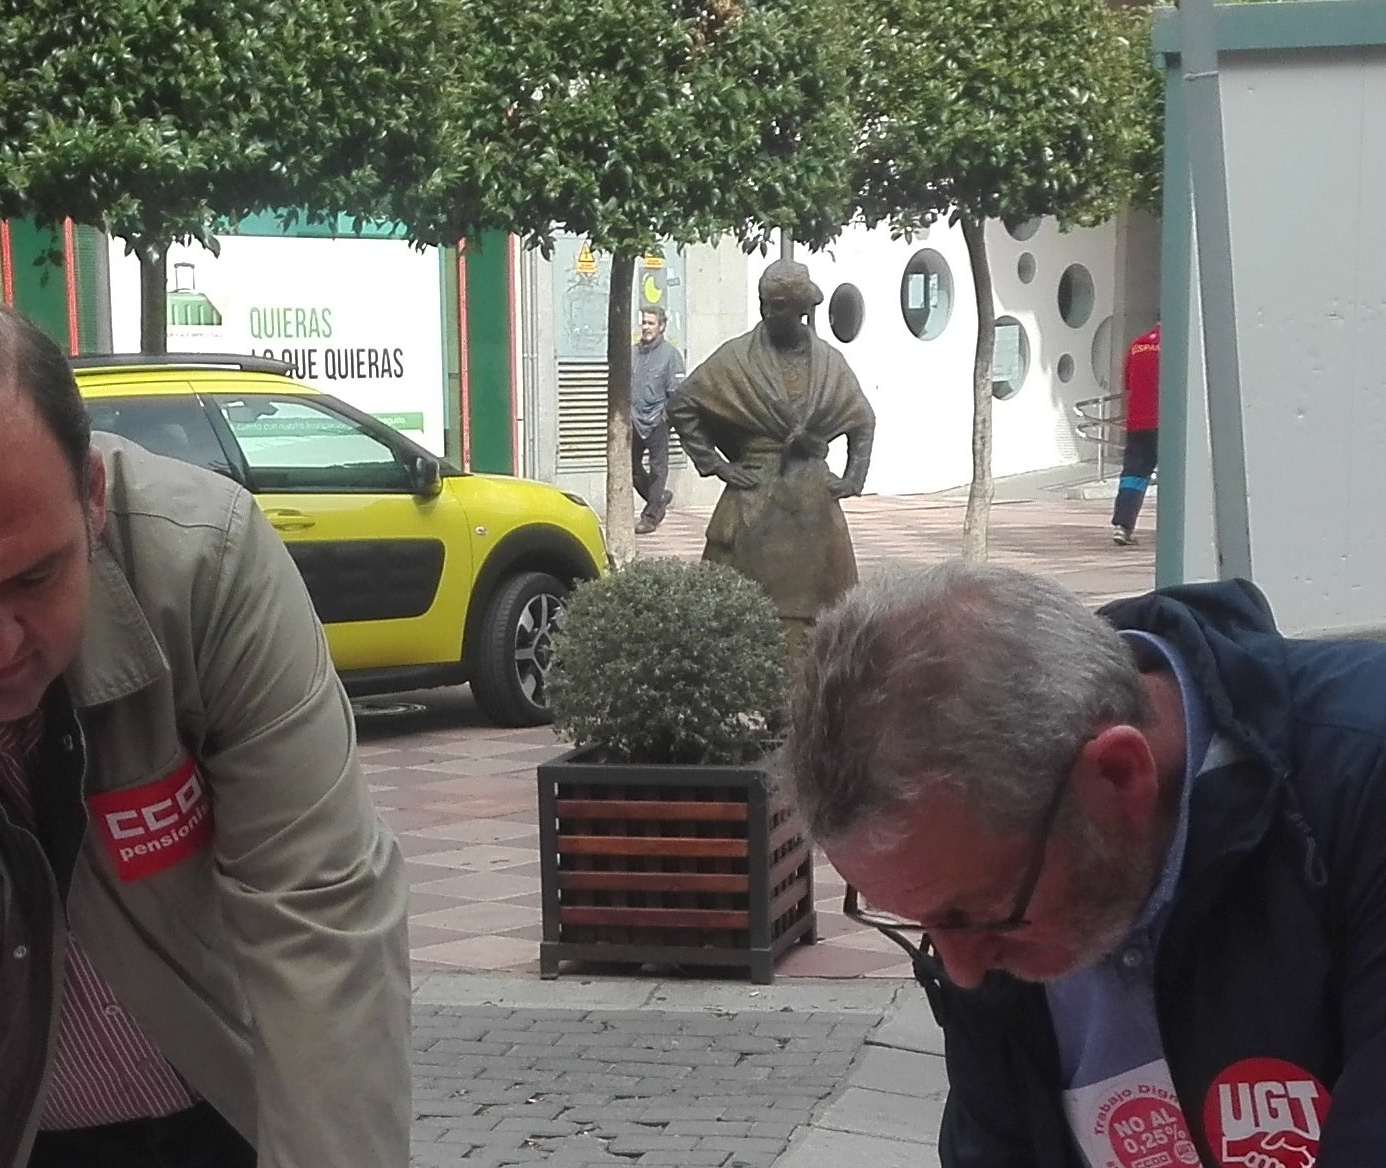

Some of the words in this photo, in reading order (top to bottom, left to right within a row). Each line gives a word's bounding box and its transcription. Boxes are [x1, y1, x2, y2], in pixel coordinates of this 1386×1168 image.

[250, 307, 332, 339] QUIERAS
[325, 348, 403, 379] QUIERAS
[106, 767, 204, 839] CCO
[1094, 1088, 1131, 1136] Trabajo
[1113, 1116, 1145, 1140] NO
[1151, 1108, 1177, 1127] AL
[1219, 1080, 1321, 1141] UGT
[1124, 1122, 1186, 1155] 0,25%
